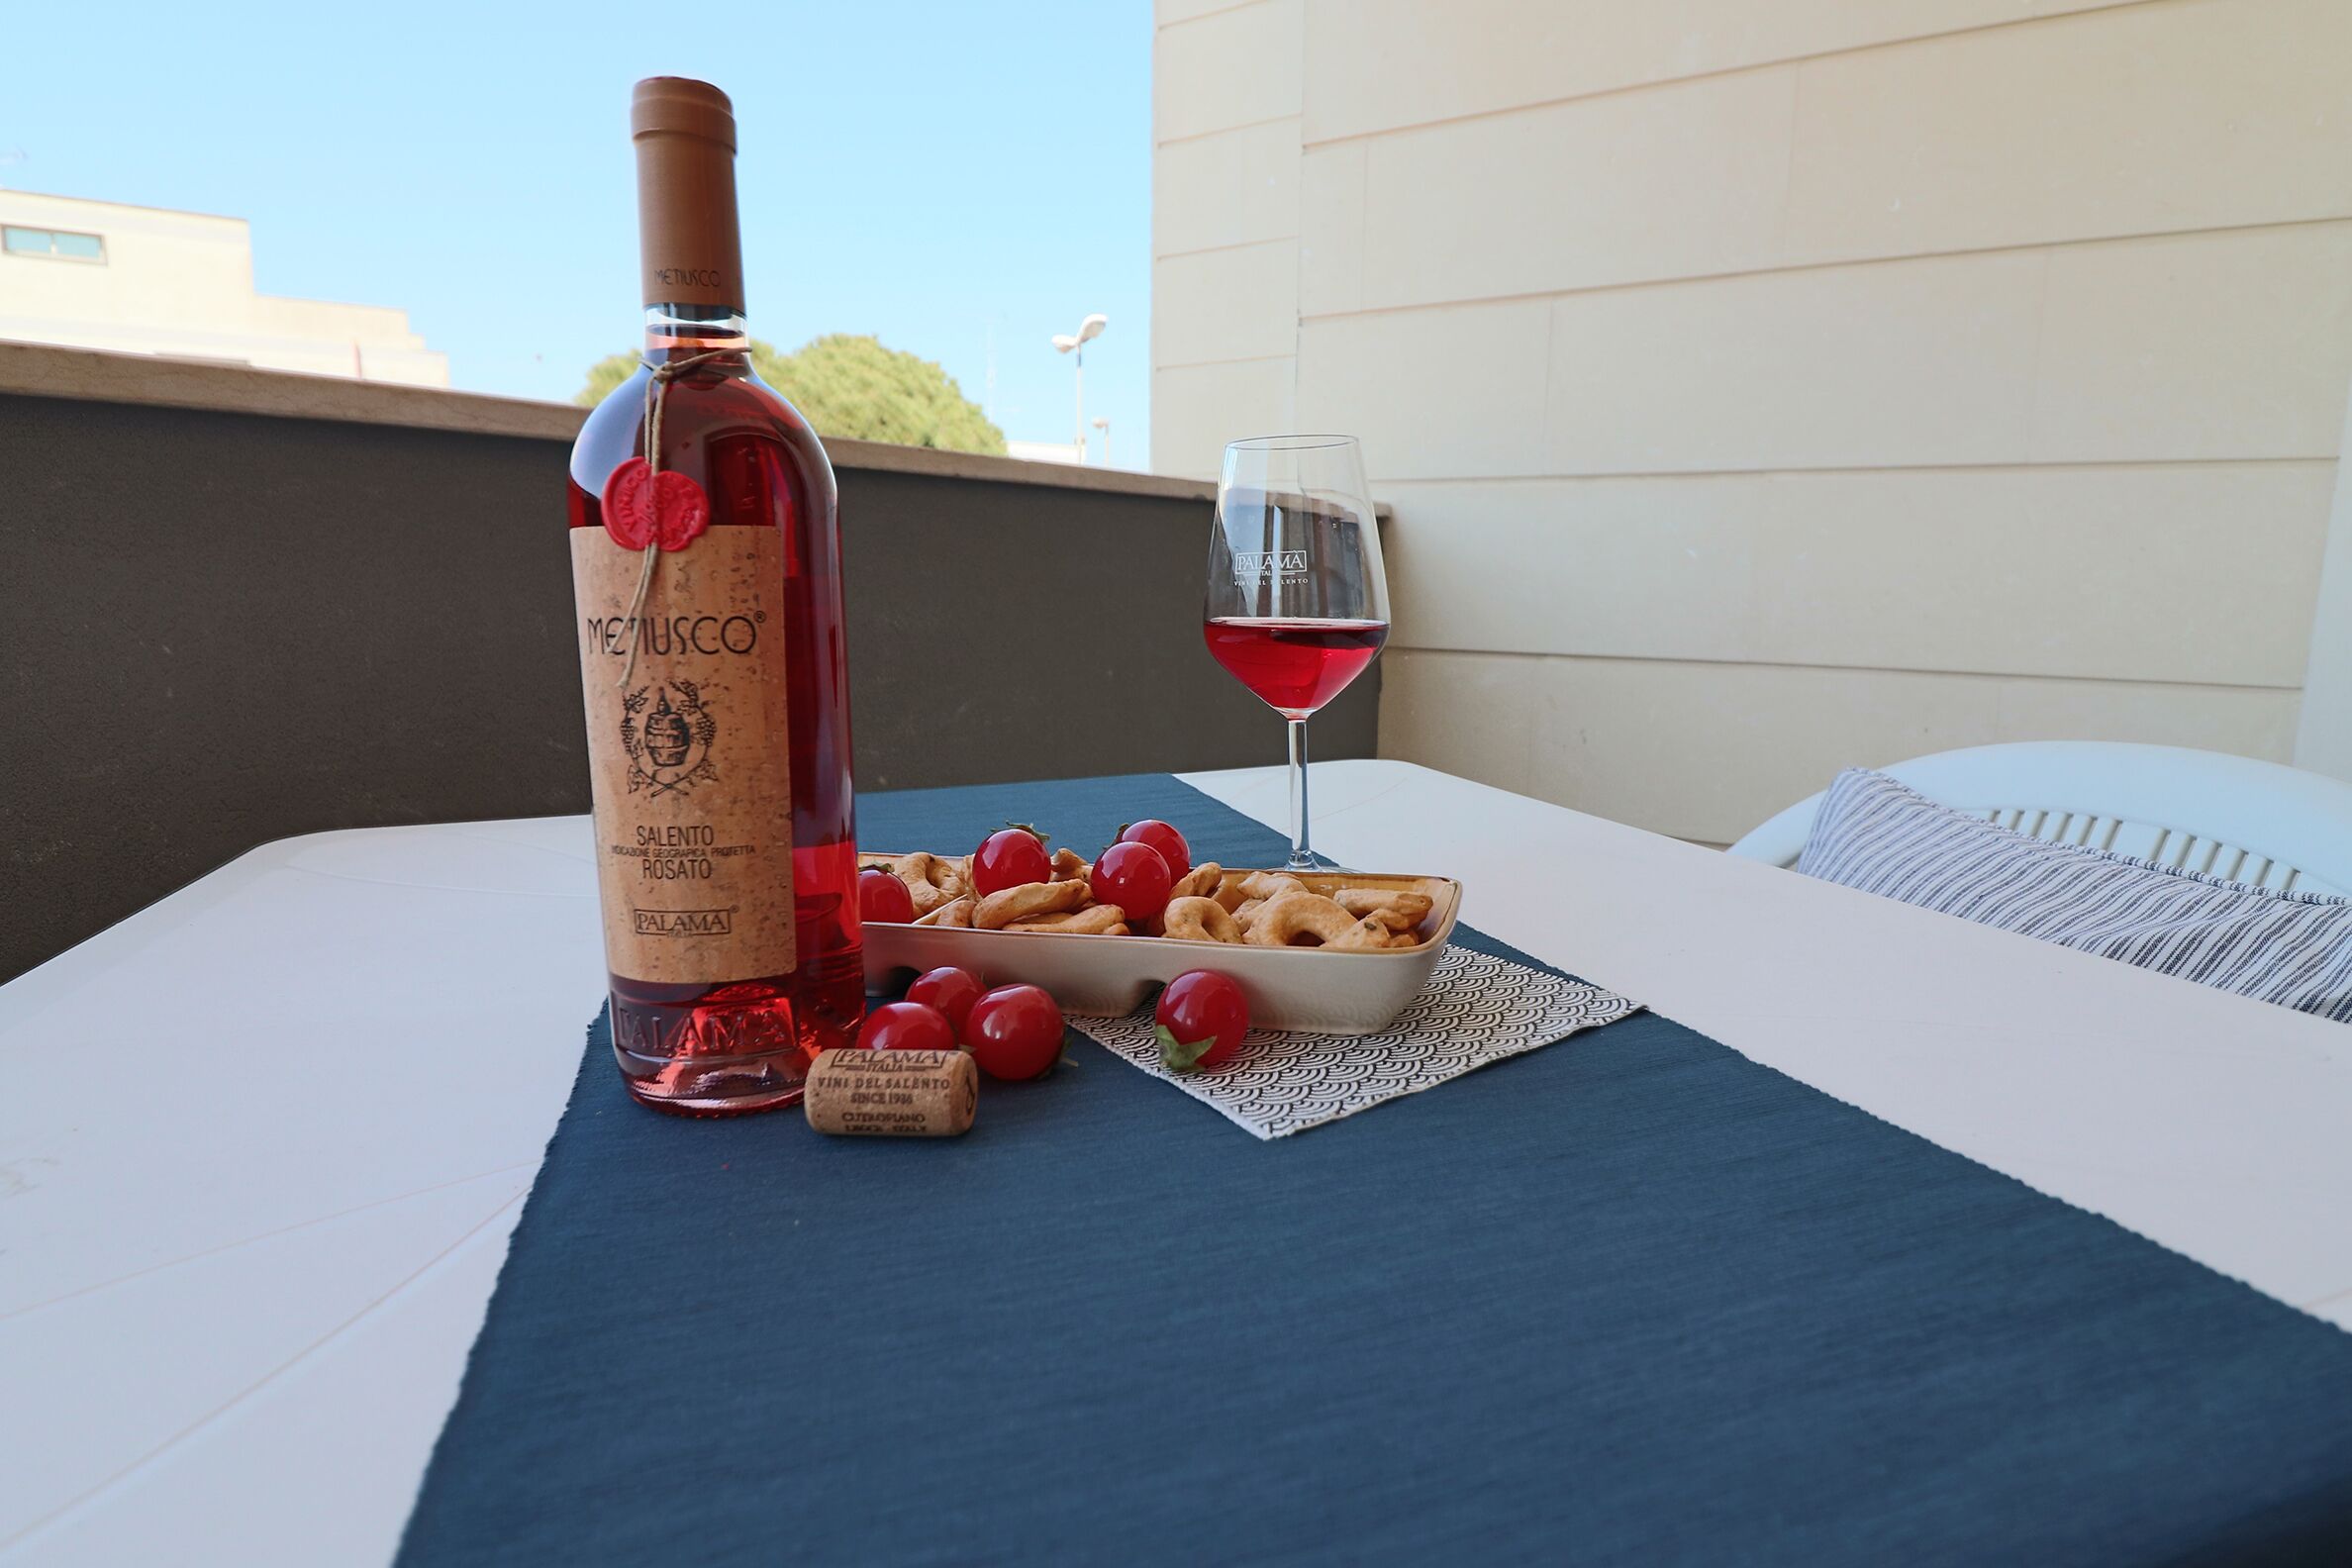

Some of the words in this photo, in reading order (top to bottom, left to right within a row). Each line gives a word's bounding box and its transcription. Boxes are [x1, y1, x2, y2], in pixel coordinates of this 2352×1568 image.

[654, 268, 721, 287] METIUSCO
[637, 825, 714, 846] SALENTO
[642, 858, 713, 879] ROSATO
[865, 1063, 904, 1073] ITALIA
[818, 1077, 849, 1089] VINI
[855, 1077, 883, 1089] DEL
[885, 1077, 951, 1090] SALENTO
[850, 1092, 887, 1105] SINCE
